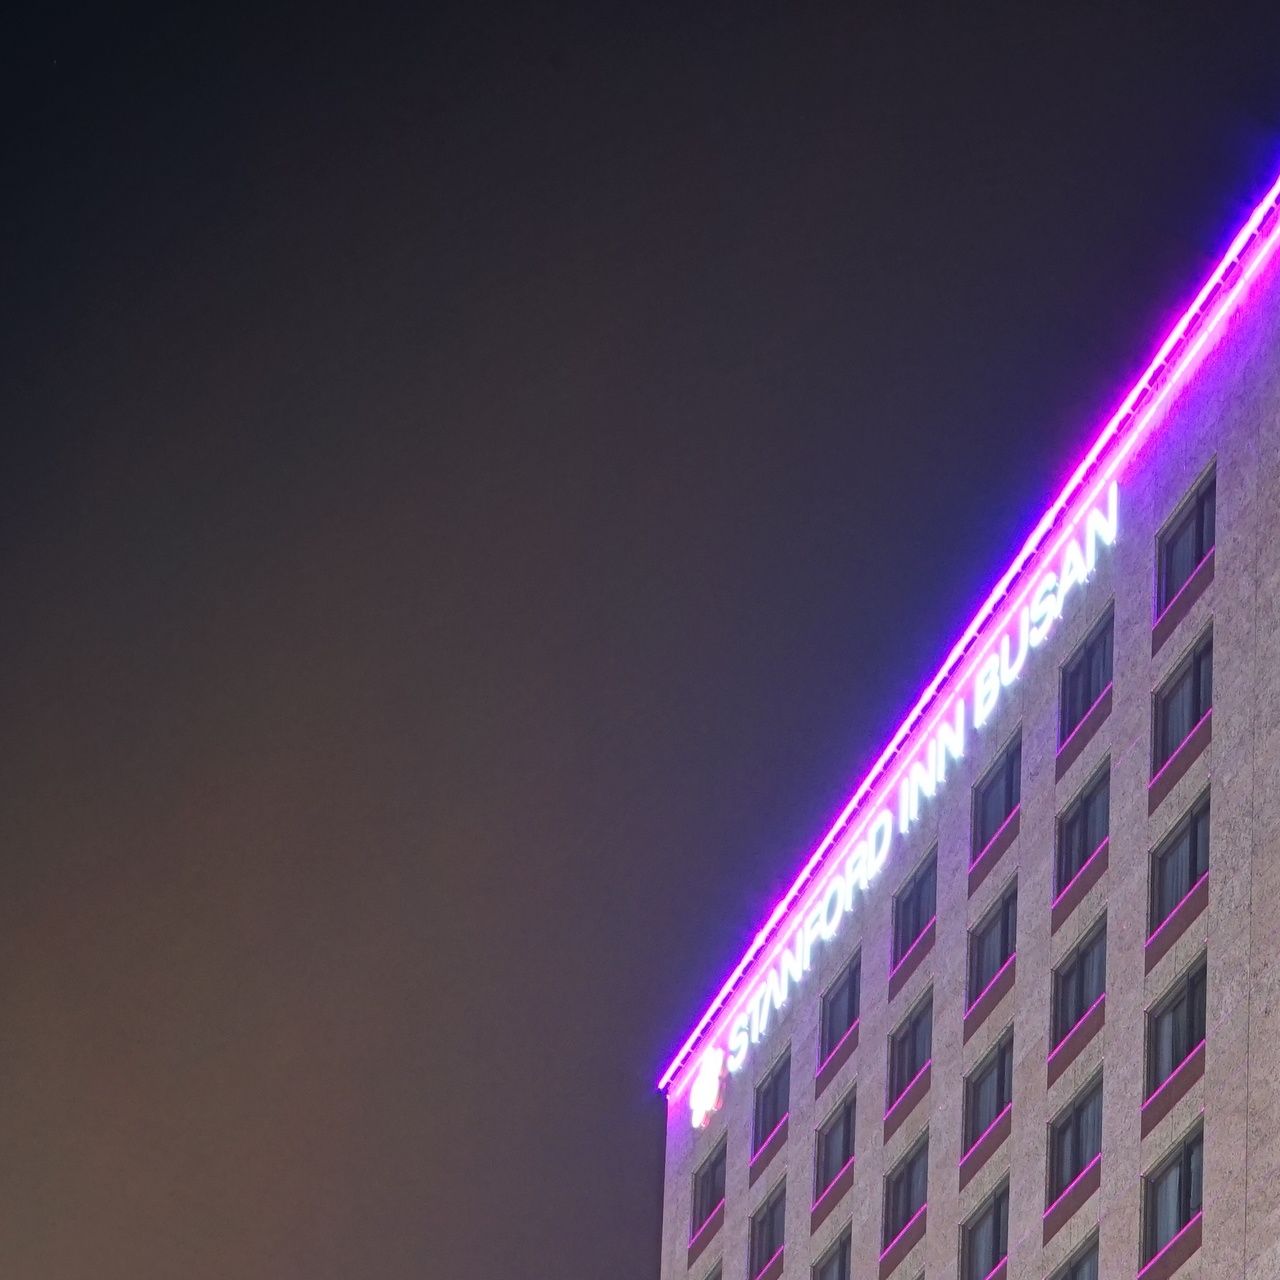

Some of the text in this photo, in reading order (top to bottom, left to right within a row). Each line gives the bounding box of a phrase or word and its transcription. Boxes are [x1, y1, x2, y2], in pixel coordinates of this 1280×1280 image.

[727, 481, 1120, 1073] STANFORD INN BUSAN
